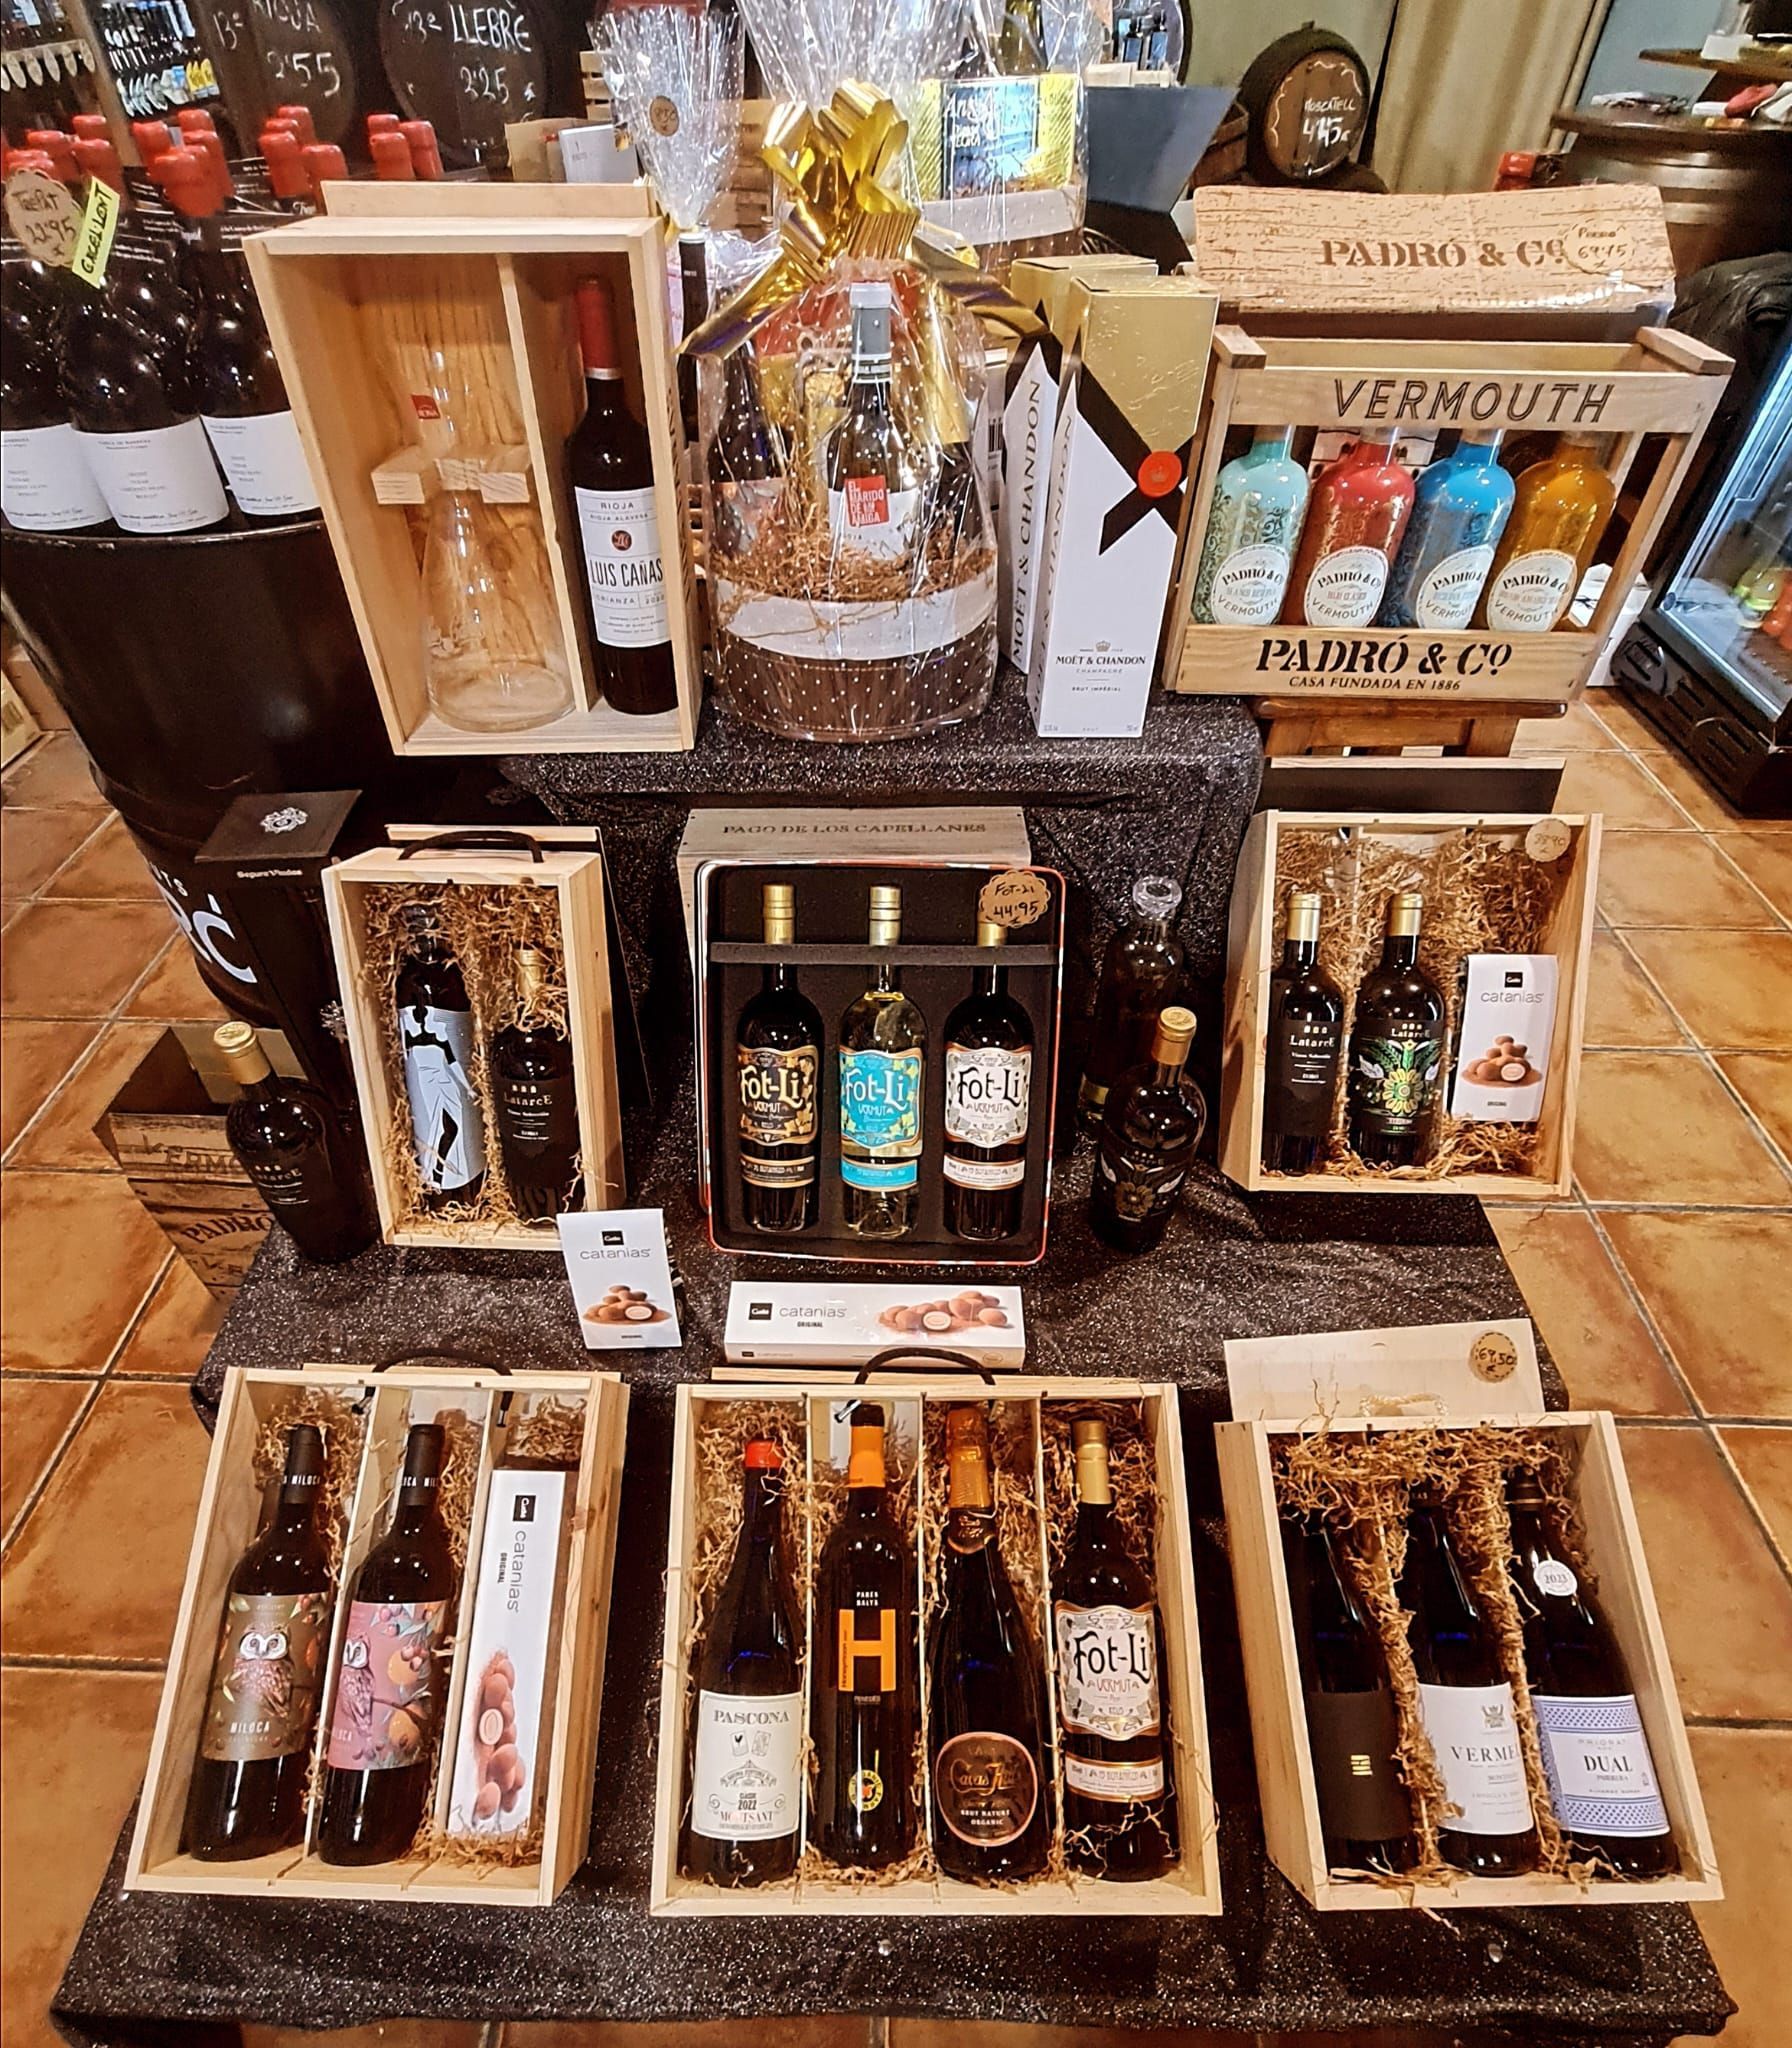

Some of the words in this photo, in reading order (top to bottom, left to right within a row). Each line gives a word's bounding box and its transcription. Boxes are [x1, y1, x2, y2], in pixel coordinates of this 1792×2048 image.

[1478, 242, 1507, 267] &
[1334, 378, 1615, 424] VERMOUTH
[1020, 380, 1040, 546] CHANDON
[601, 502, 635, 511] RIOJA
[590, 559, 618, 587] LUIS
[621, 557, 664, 587] CAÑAS
[1217, 593, 1279, 617] VERMOUTH
[1312, 597, 1375, 619] VERMOUTH
[1096, 655, 1146, 665] CHANDON
[1256, 635, 1409, 674] PADRÓ
[1418, 643, 1447, 674] &
[1289, 676, 1325, 688] CASA
[1330, 677, 1402, 689] FUNDADA
[1406, 679, 1427, 690] EN
[1431, 679, 1461, 691] 1886
[723, 826, 776, 834] PAGO
[781, 825, 808, 834] DE
[812, 825, 849, 834] LOS
[854, 824, 987, 834] CAPELLANES
[1481, 991, 1544, 1004] catanias
[741, 1065, 804, 1109] Fot-Li
[846, 1067, 908, 1112] Fot-Li
[957, 1066, 1022, 1108] Fot-Li
[580, 1248, 650, 1261] catanias
[779, 1304, 847, 1319] catanias
[507, 1530, 528, 1613] catanias
[838, 1608, 897, 1692] H
[1073, 1629, 1151, 1687] Fot-Li
[230, 1720, 271, 1734] MILOCA
[714, 1709, 790, 1725] PASCONA
[1583, 1754, 1633, 1773] DUAL
[738, 1799, 757, 1811] 2022
